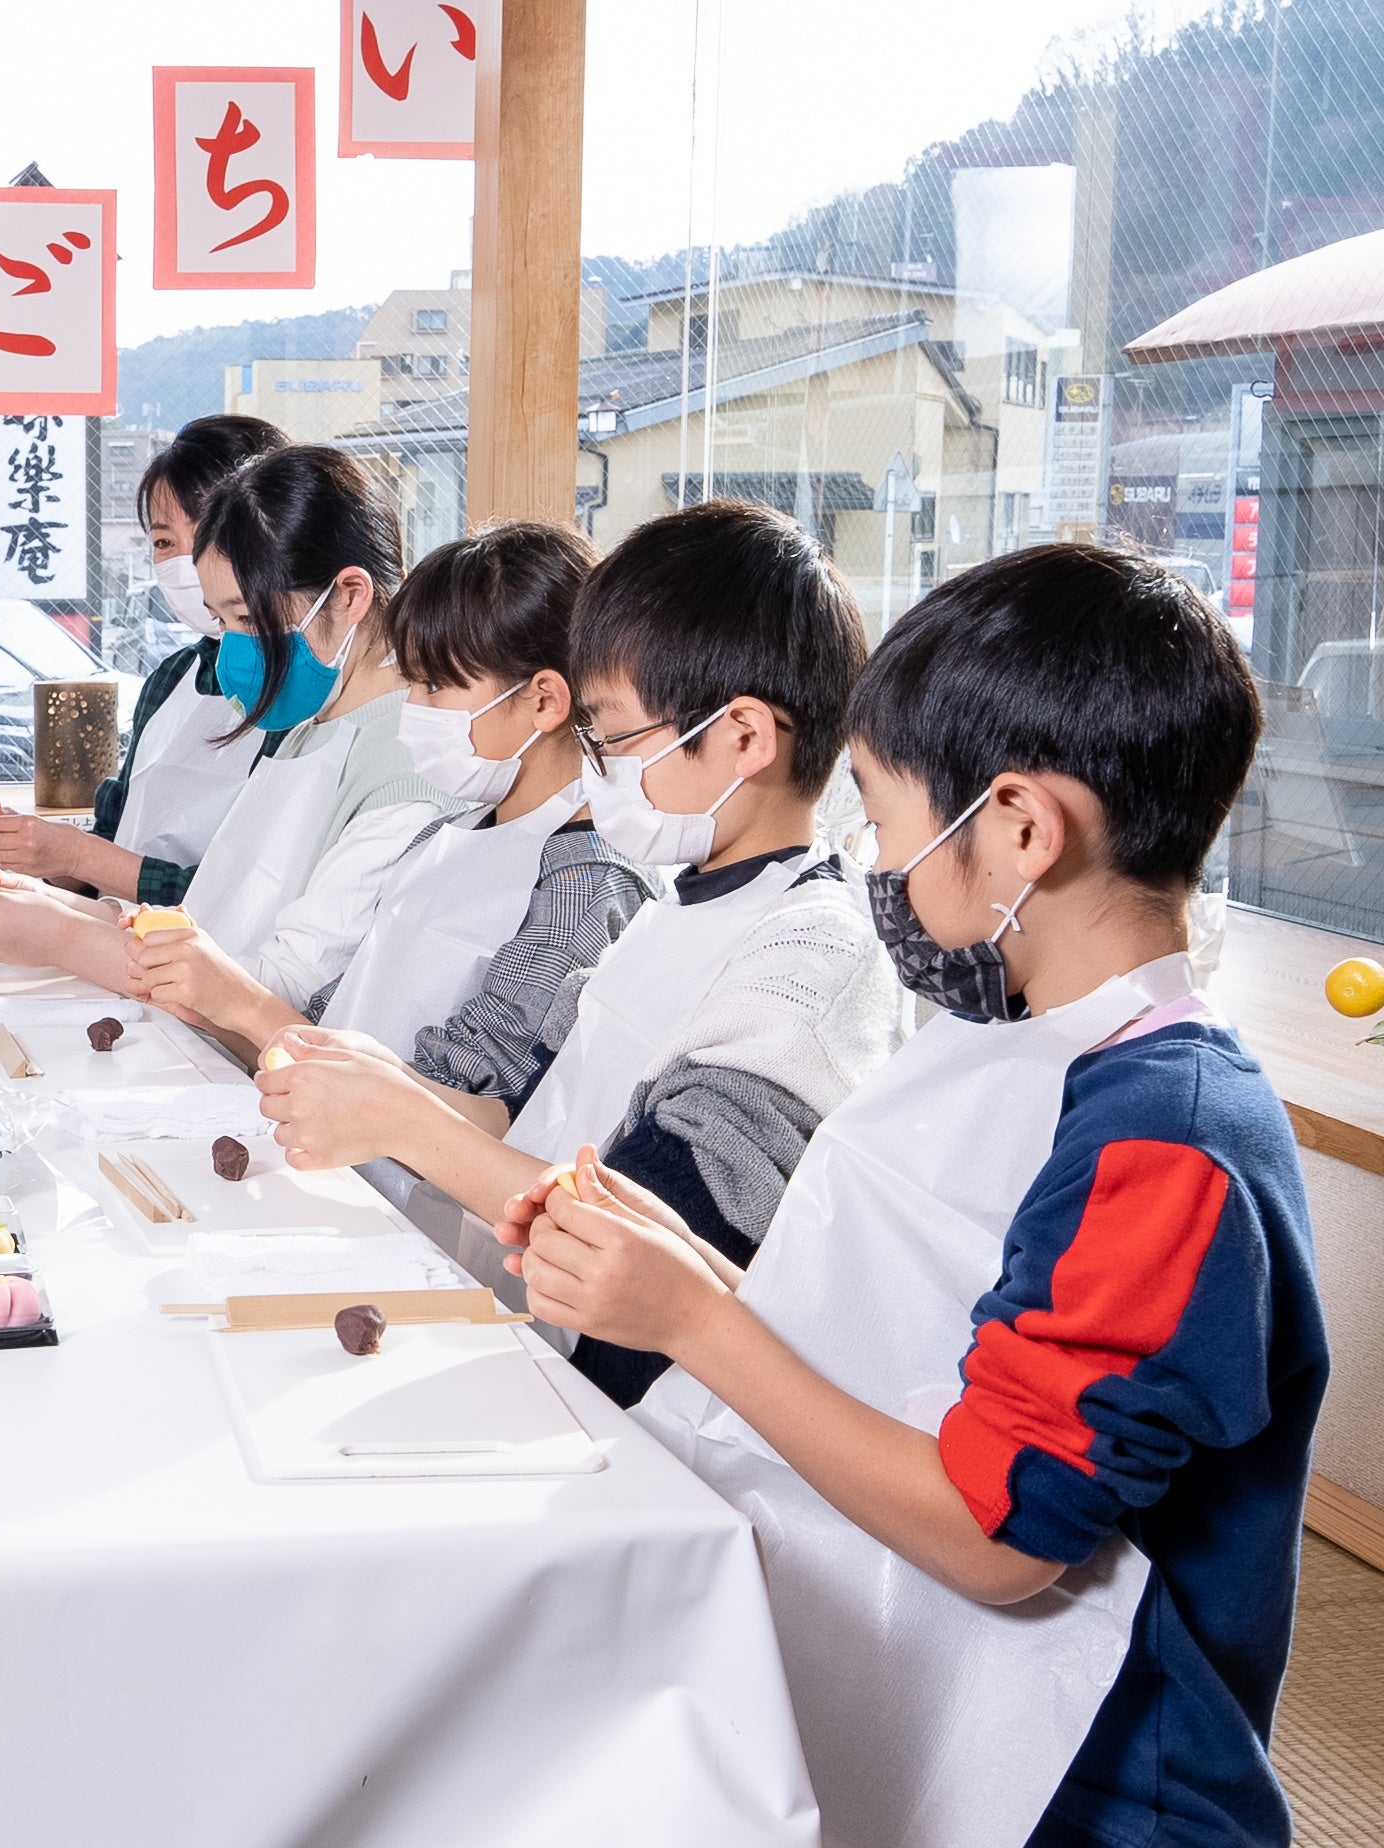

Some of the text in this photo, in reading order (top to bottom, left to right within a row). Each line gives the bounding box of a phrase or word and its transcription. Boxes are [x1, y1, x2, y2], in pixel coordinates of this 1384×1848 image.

[361, 3, 476, 102] い
[195, 100, 290, 254] ち
[275, 377, 364, 394] SUBARU
[1124, 486, 1172, 503] SUBARU
